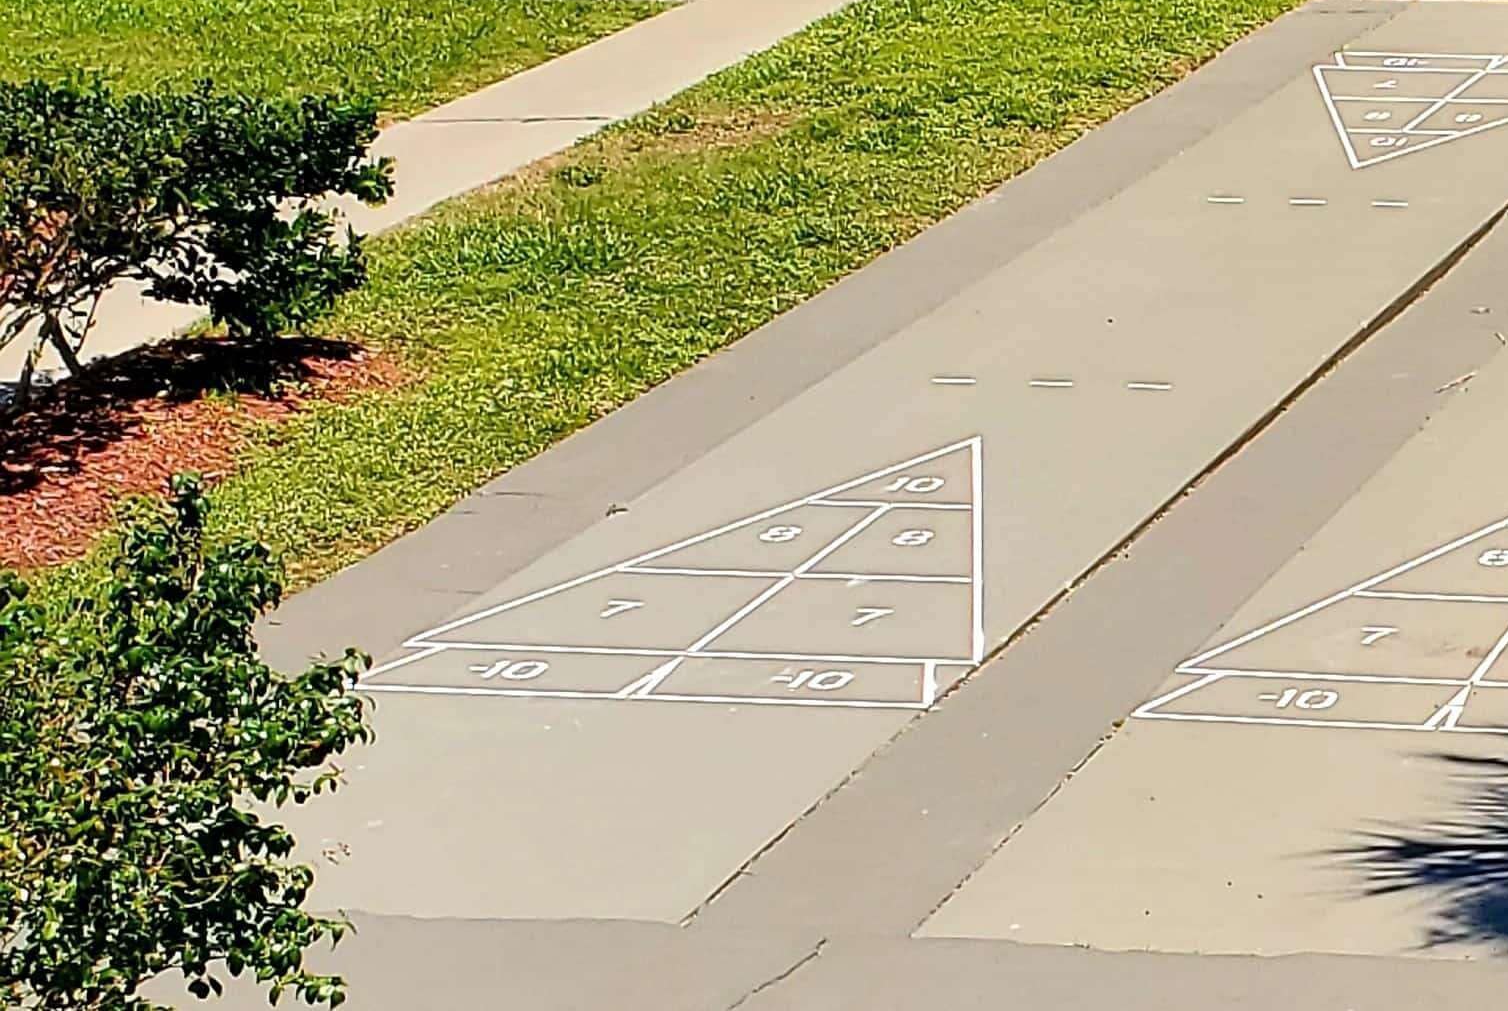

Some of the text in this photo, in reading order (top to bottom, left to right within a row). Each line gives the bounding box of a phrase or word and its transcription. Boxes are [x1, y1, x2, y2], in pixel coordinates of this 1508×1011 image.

[884, 476, 945, 492] 10
[759, 525, 802, 542] 8
[892, 530, 935, 546] 8
[600, 600, 645, 618] 7
[852, 607, 895, 626] 7
[1361, 626, 1398, 645] 7
[468, 660, 549, 679] -10
[770, 669, 855, 690] -10
[1257, 688, 1339, 709] -10
